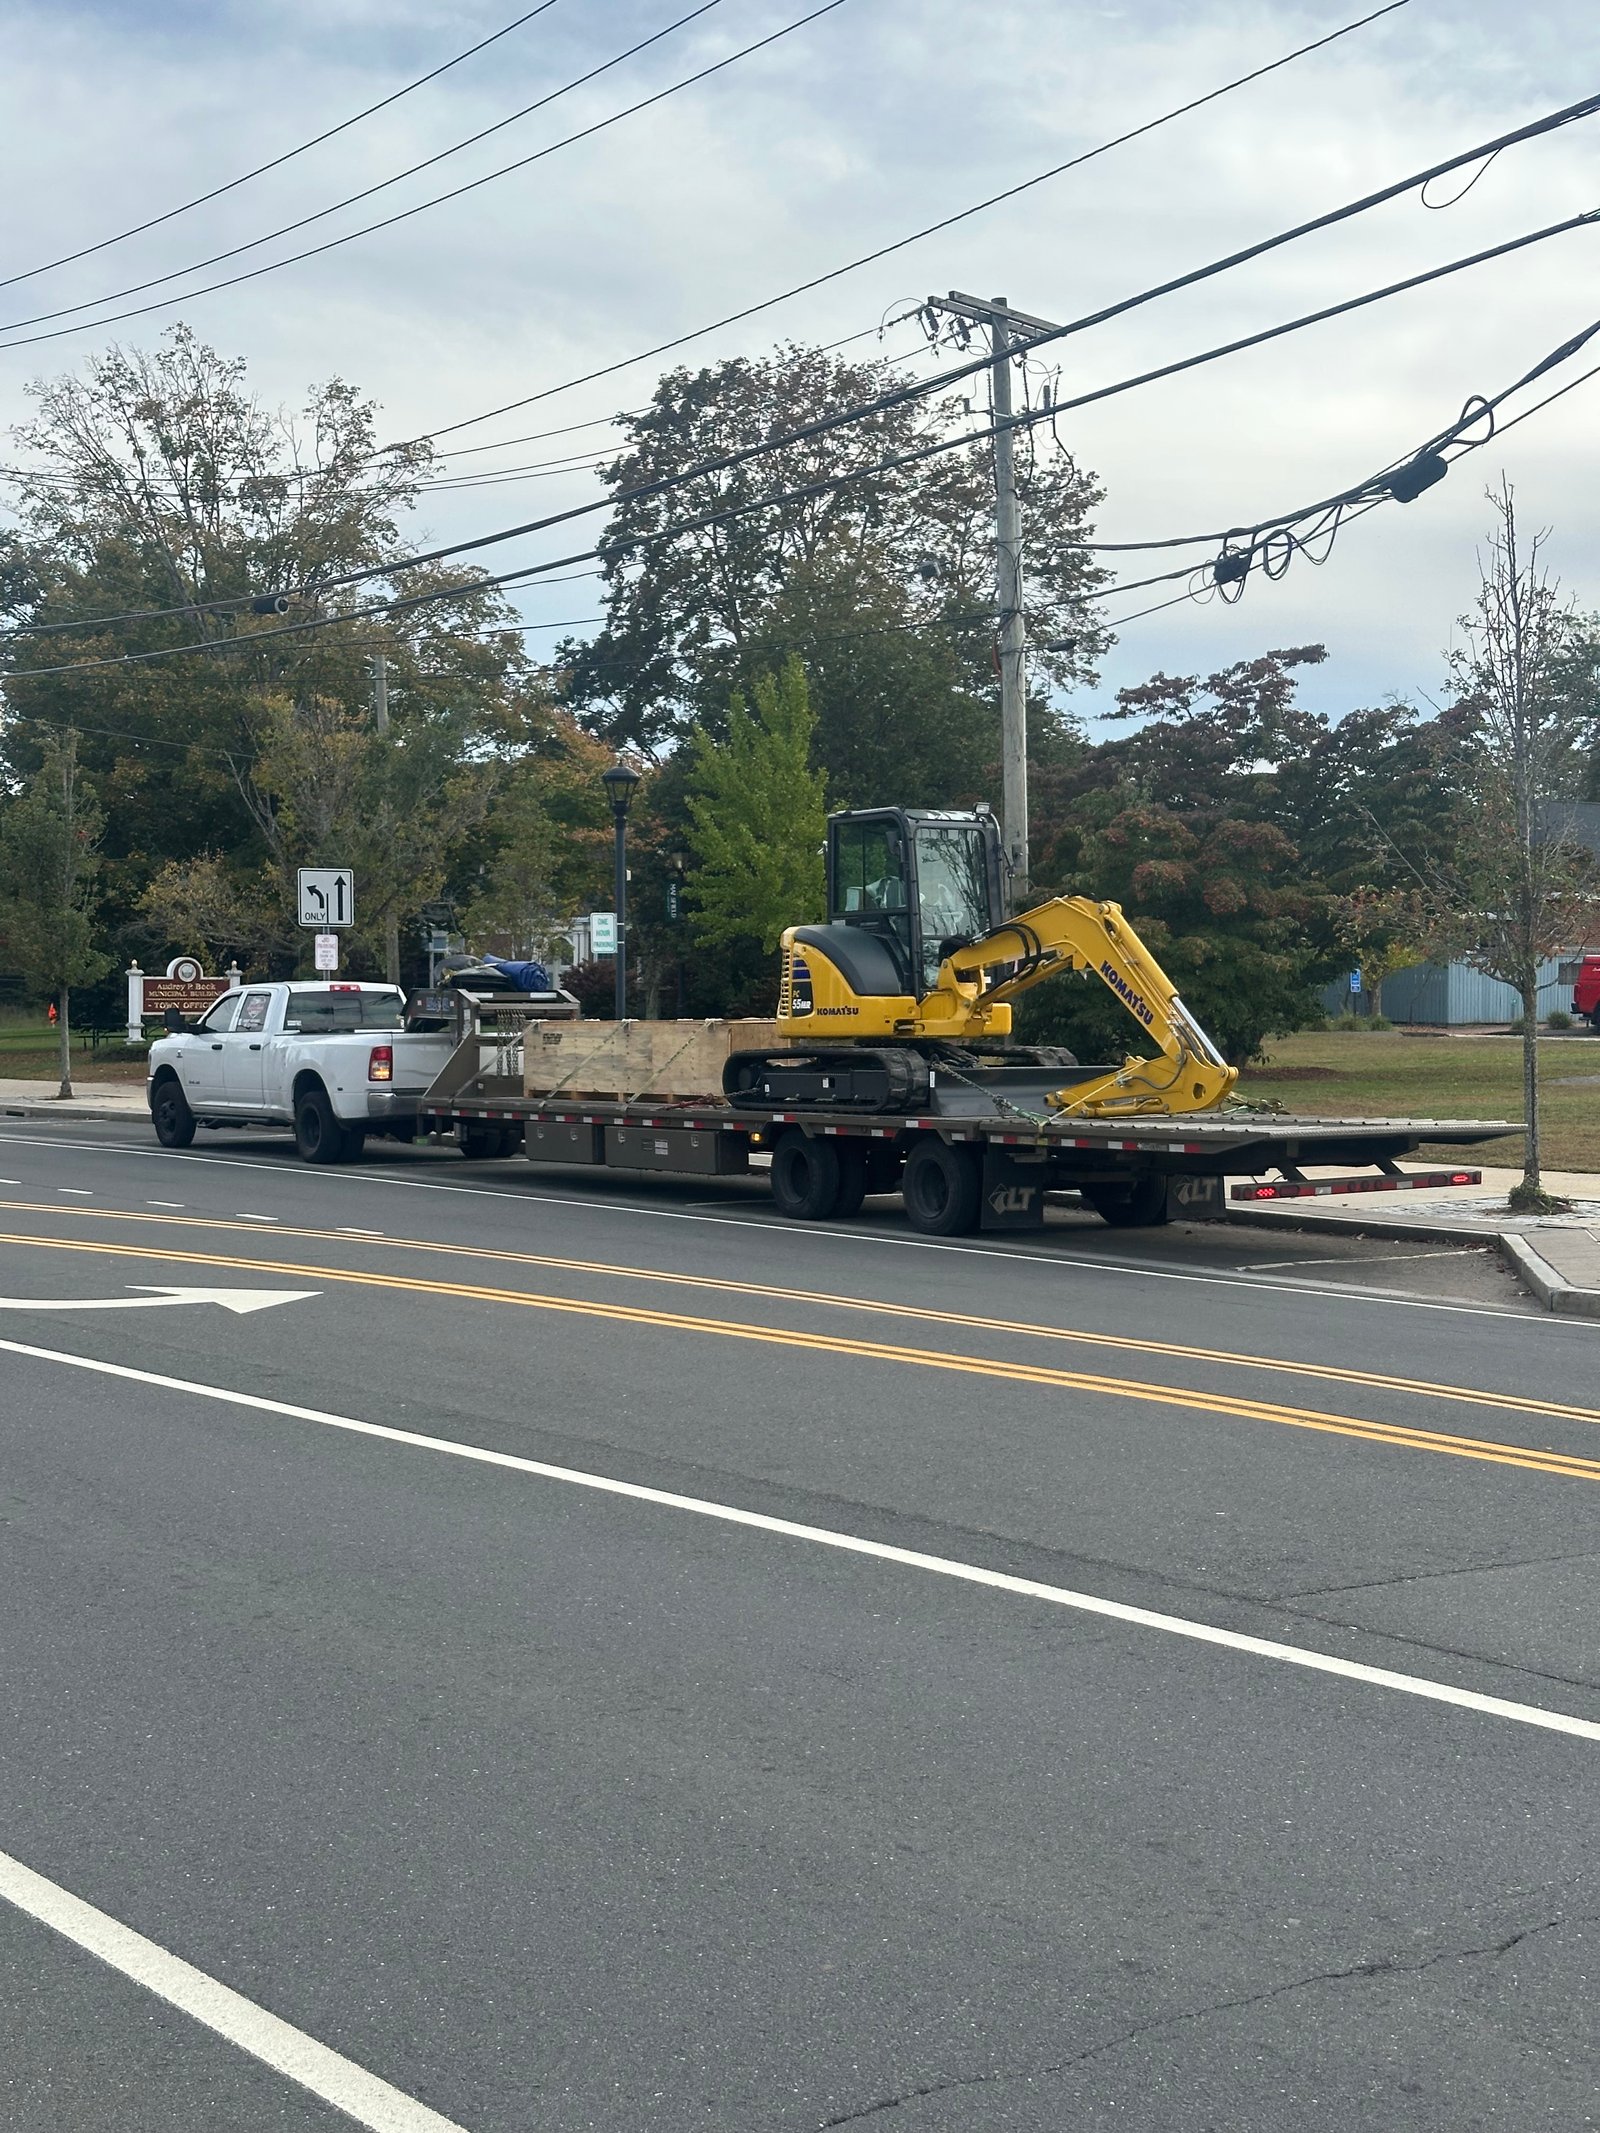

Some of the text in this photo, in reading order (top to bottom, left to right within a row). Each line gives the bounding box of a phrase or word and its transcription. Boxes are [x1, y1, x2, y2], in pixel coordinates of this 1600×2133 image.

[305, 912, 326, 921] ONLY
[1100, 960, 1154, 1025] KOMATSU
[817, 1006, 859, 1015] KOMATSU
